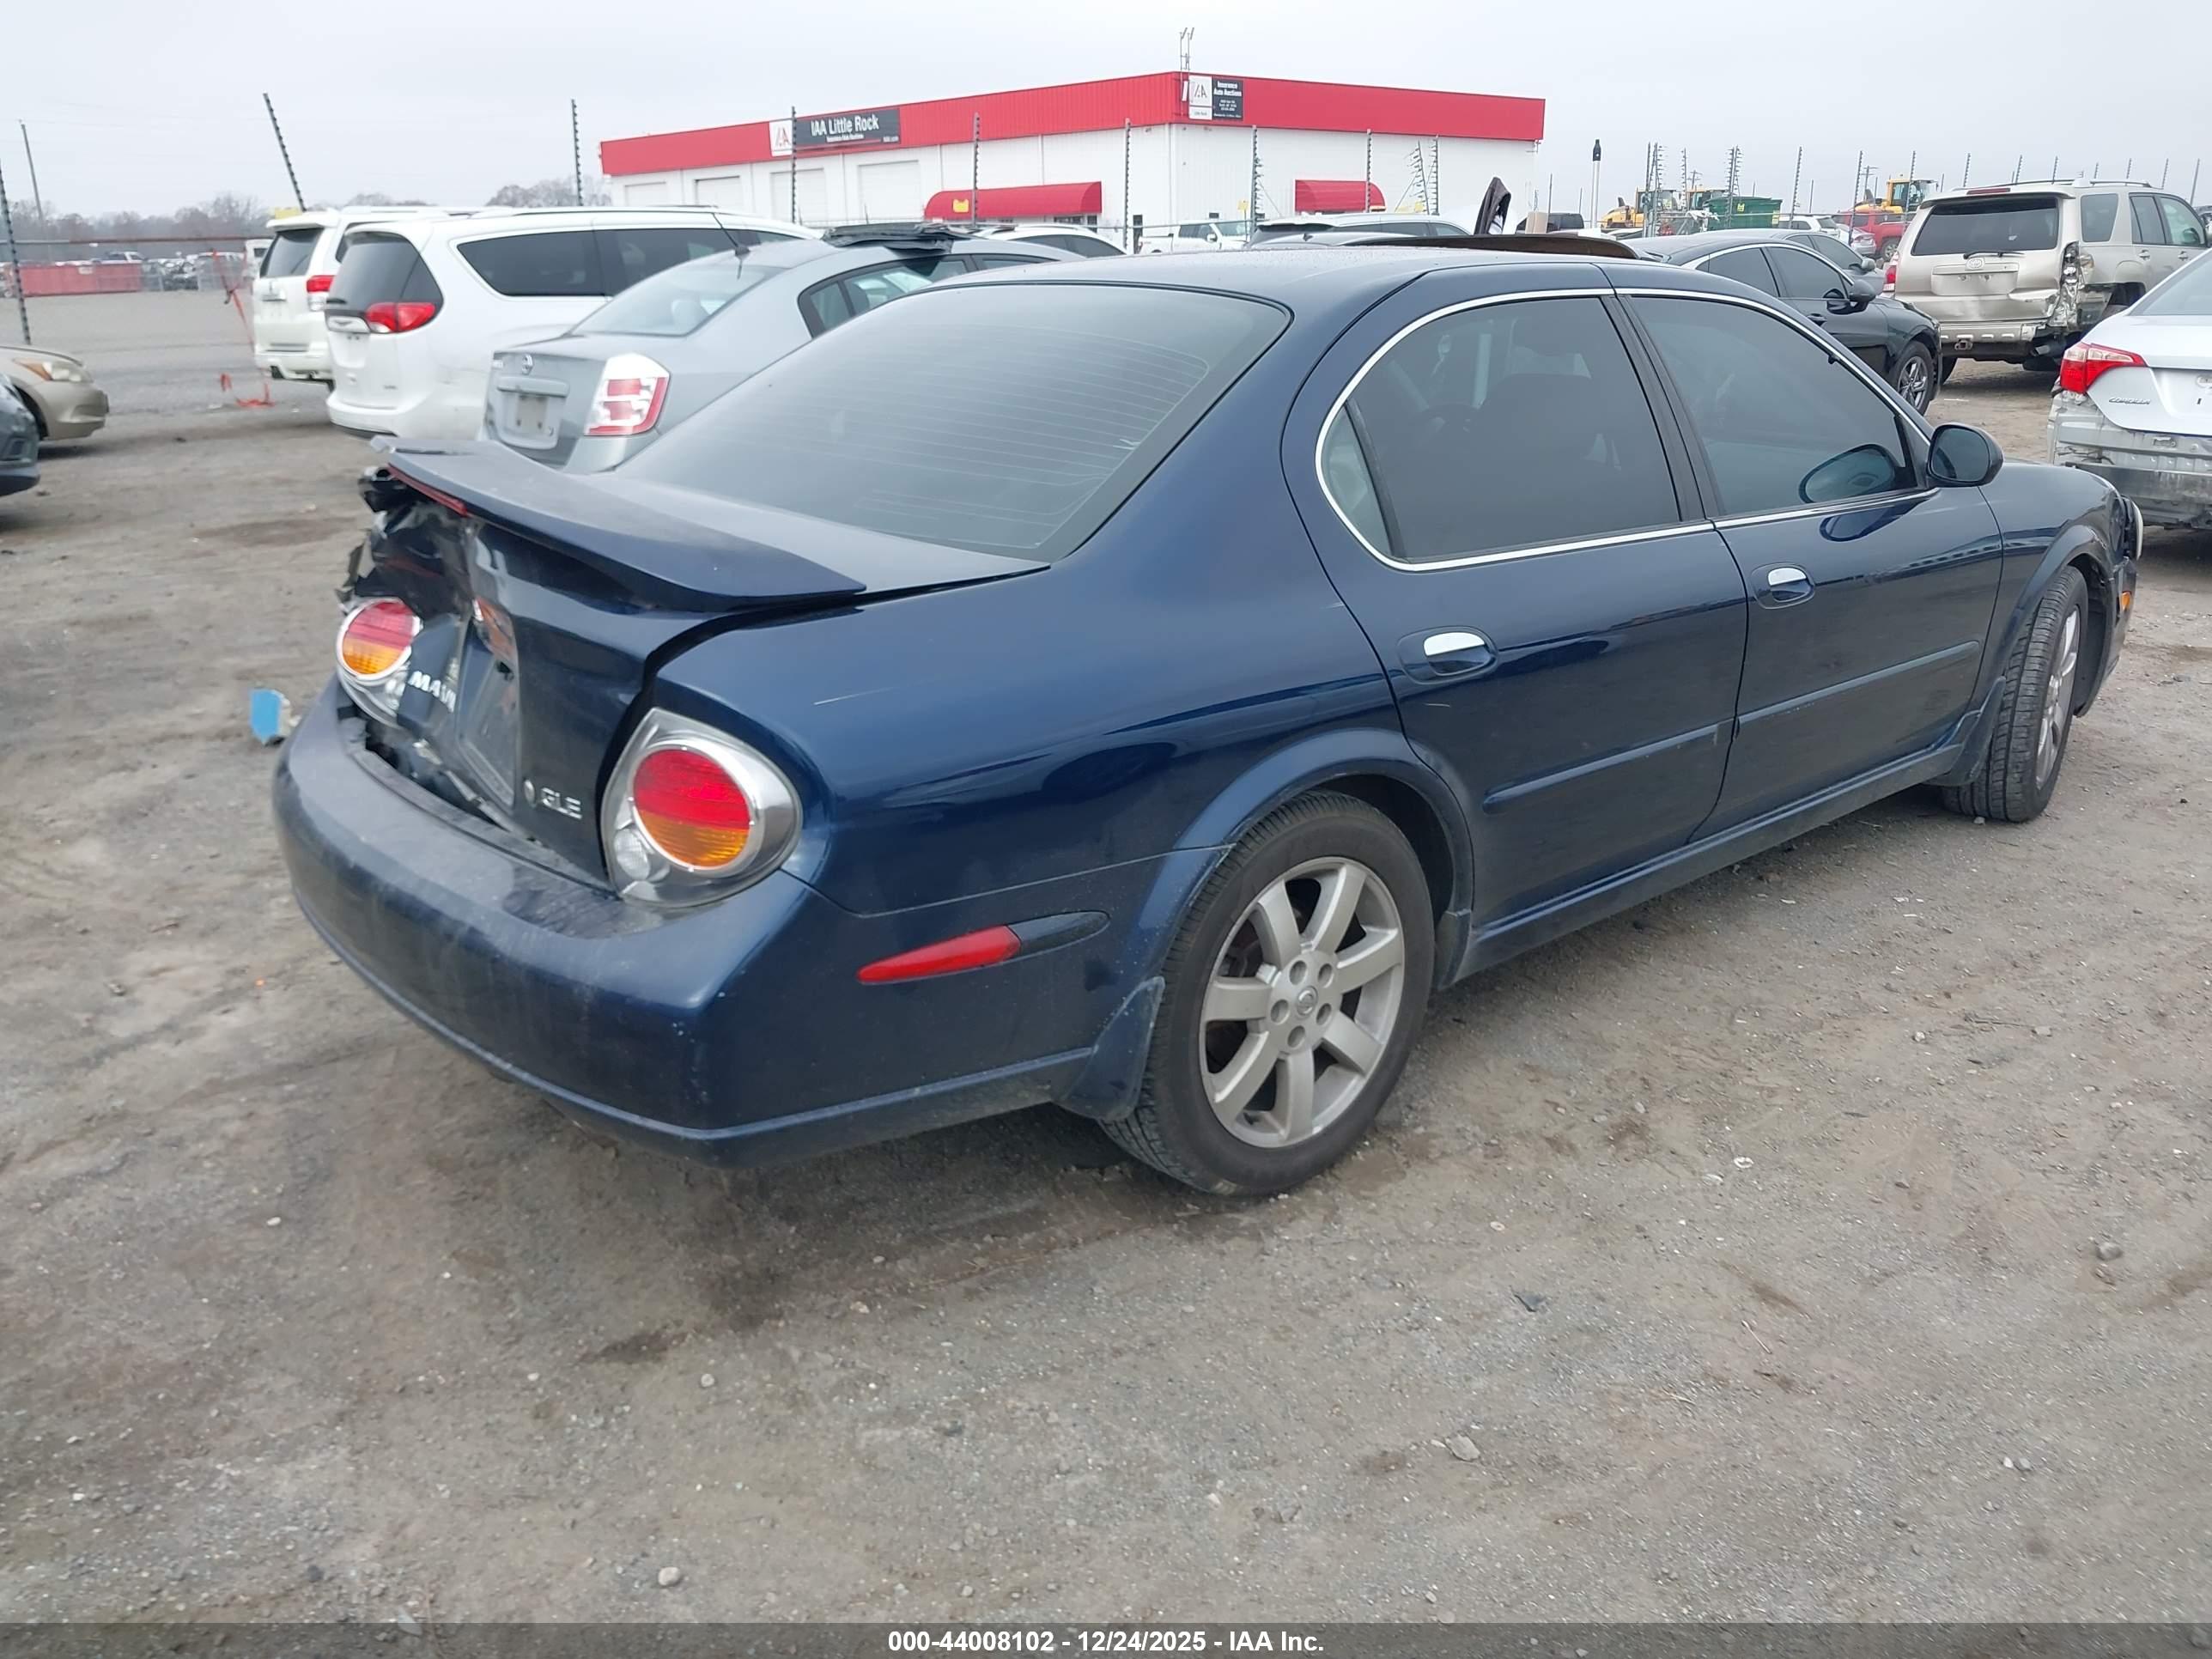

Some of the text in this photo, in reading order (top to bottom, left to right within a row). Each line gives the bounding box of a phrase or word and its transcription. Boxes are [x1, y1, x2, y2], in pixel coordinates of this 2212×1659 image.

[811, 113, 879, 137] IAA Little Rock
[540, 787, 583, 820] GLE
